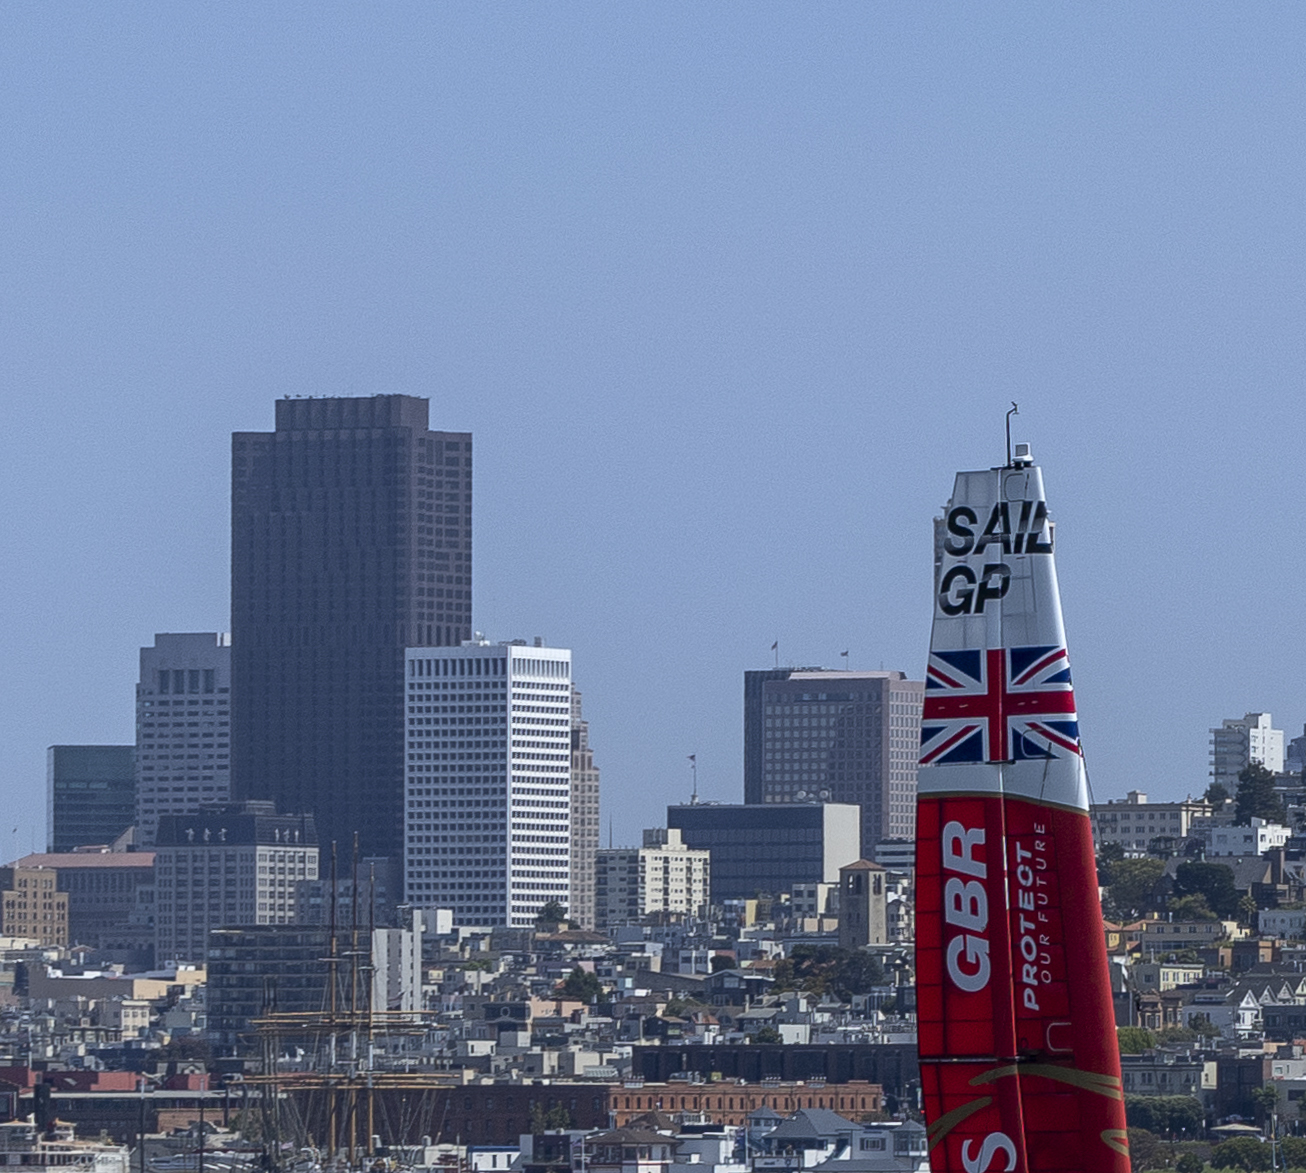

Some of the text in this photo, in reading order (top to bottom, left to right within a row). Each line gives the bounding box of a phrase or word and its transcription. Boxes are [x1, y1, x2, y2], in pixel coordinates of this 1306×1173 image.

[938, 563, 1011, 616] GP
[944, 501, 1054, 558] SAIL
[942, 820, 992, 994] GBR
[1016, 841, 1040, 1012] PROTECT
[1034, 822, 1052, 983] OUR FUTURE
